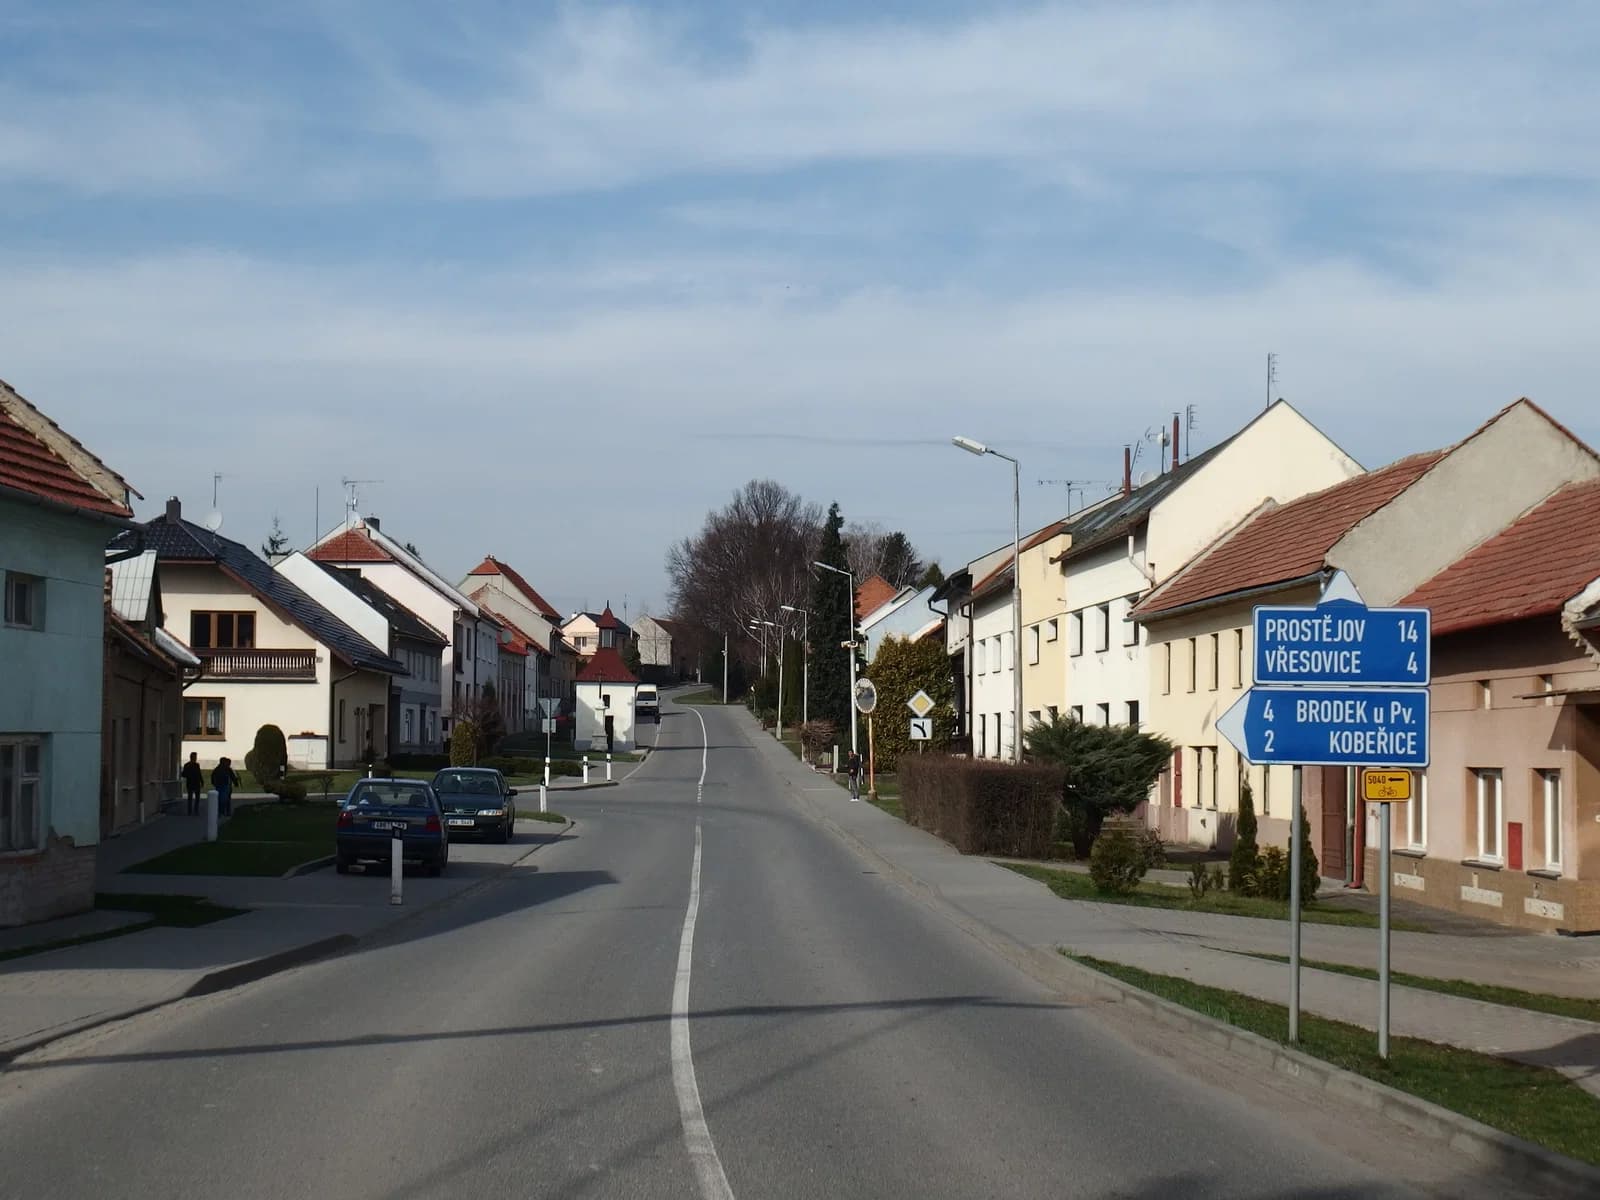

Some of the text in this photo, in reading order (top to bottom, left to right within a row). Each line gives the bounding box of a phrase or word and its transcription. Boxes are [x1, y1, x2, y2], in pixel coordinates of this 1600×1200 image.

[1265, 614, 1419, 643] PROSTĚJOV 14
[1265, 645, 1419, 674] VŘESOVICE 4
[1263, 699, 1416, 725] 4 BRODEK u Pv.
[1264, 727, 1418, 755] 2 KOBEŘICE
[1367, 775, 1386, 785] 5040
